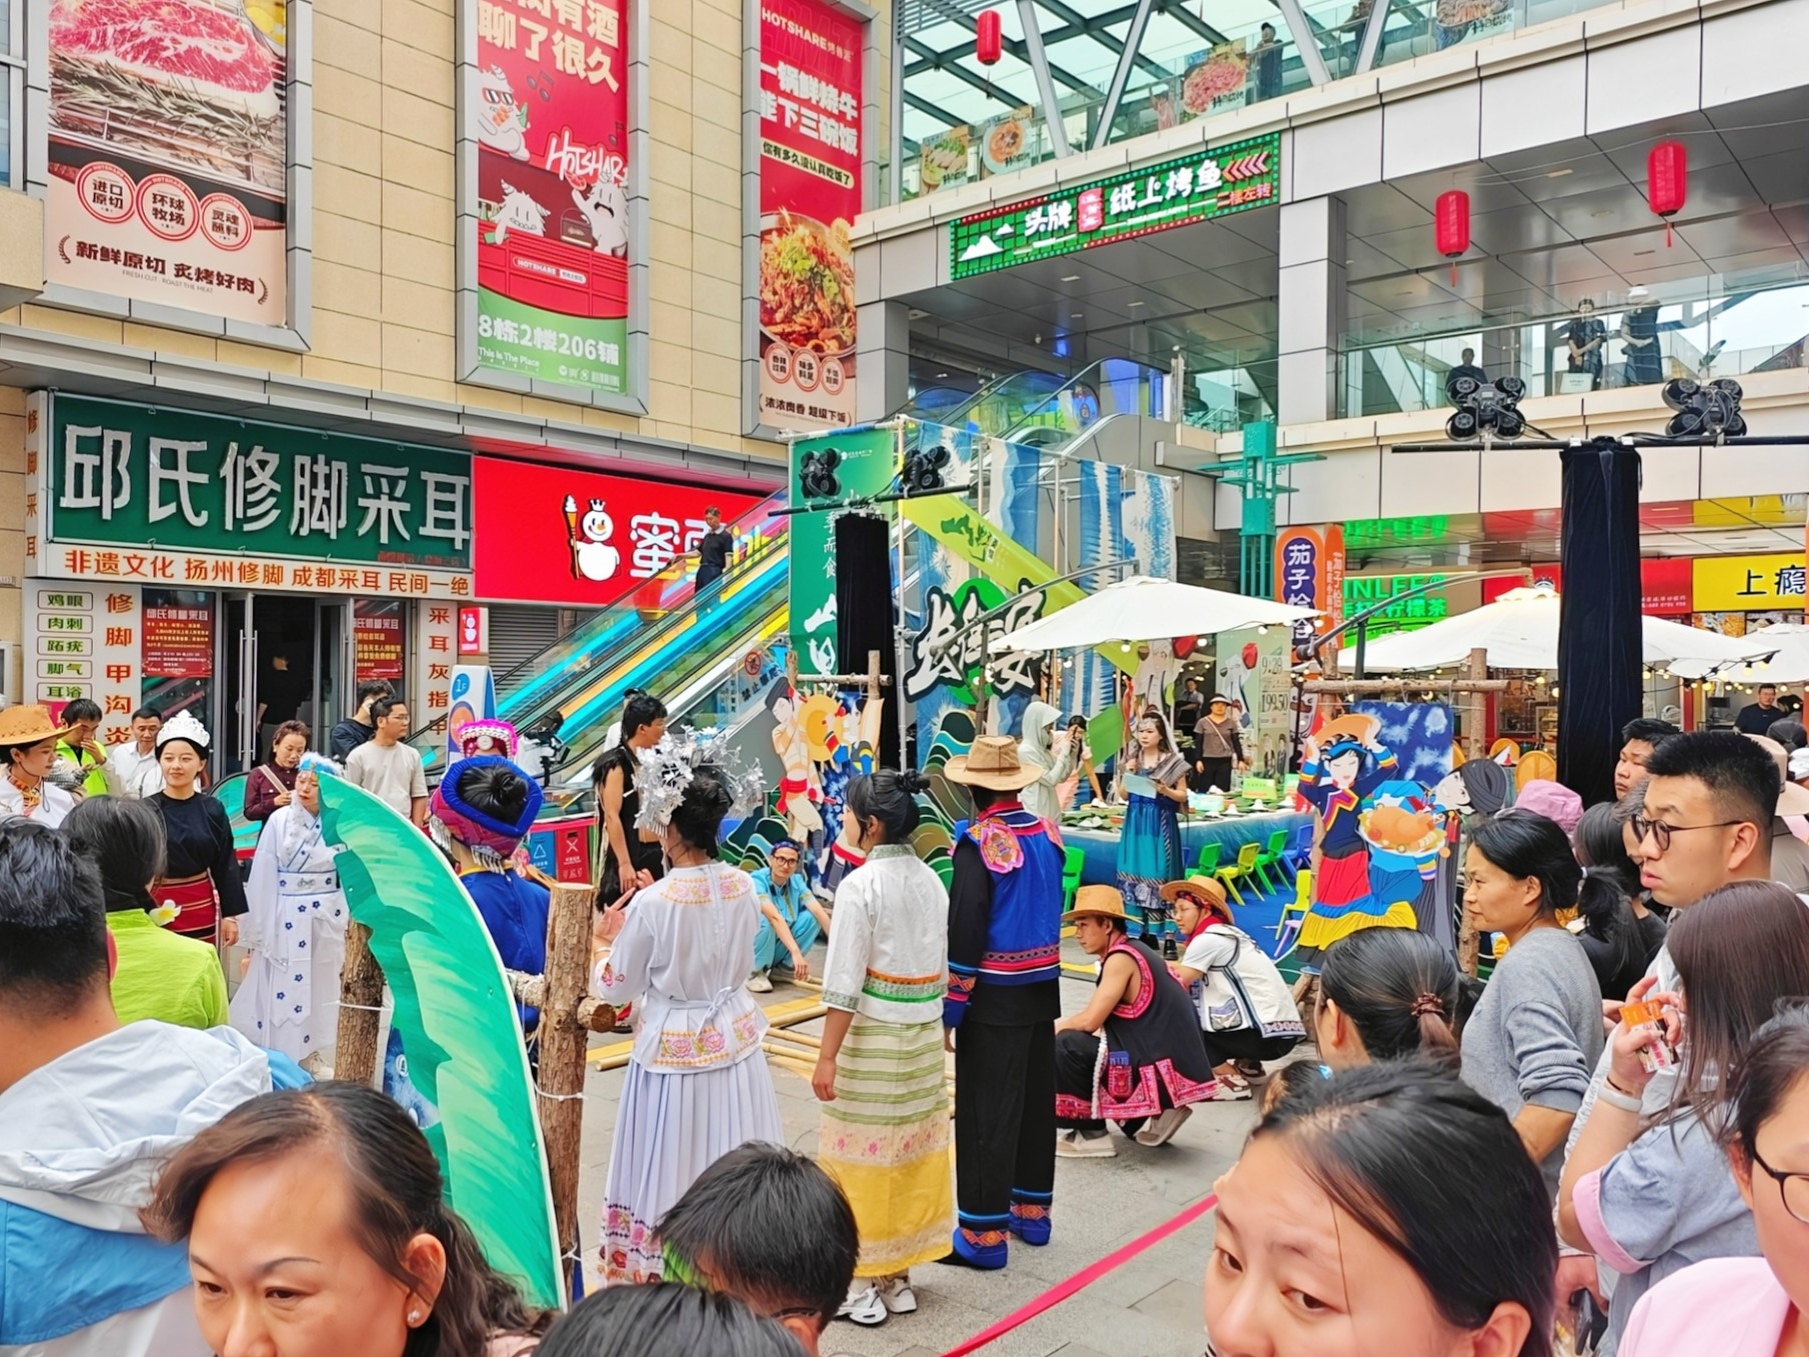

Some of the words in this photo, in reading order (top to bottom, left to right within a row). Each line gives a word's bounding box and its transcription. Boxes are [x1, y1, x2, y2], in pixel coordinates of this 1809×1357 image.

[761, 8, 828, 51] HOTSHARE
[478, 2, 620, 94] 聊了很久
[92, 178, 124, 198] 进口
[92, 191, 124, 211] 原切
[151, 192, 186, 212] 环球
[1024, 200, 1073, 237] 头牌
[1110, 159, 1223, 215] 纸上烤鱼
[151, 207, 186, 227] 牧场
[75, 240, 167, 276] 新鲜原切
[173, 262, 256, 295] 炙烤好肉
[26, 409, 38, 560] 修脚采耳
[59, 423, 471, 551] 邱氏修脚采耳
[64, 549, 175, 580] 非遗文化
[184, 557, 285, 588] 扬州修脚
[291, 568, 382, 592] 成都采耳
[388, 572, 470, 596] 民间一绝
[1736, 564, 1806, 597] 上瘾
[47, 594, 84, 608] 鸡眼
[47, 617, 83, 631] 肉刺
[46, 662, 83, 676] 脚气
[104, 592, 134, 745] 修脚甲沟炎
[46, 685, 83, 699] 耳浴
